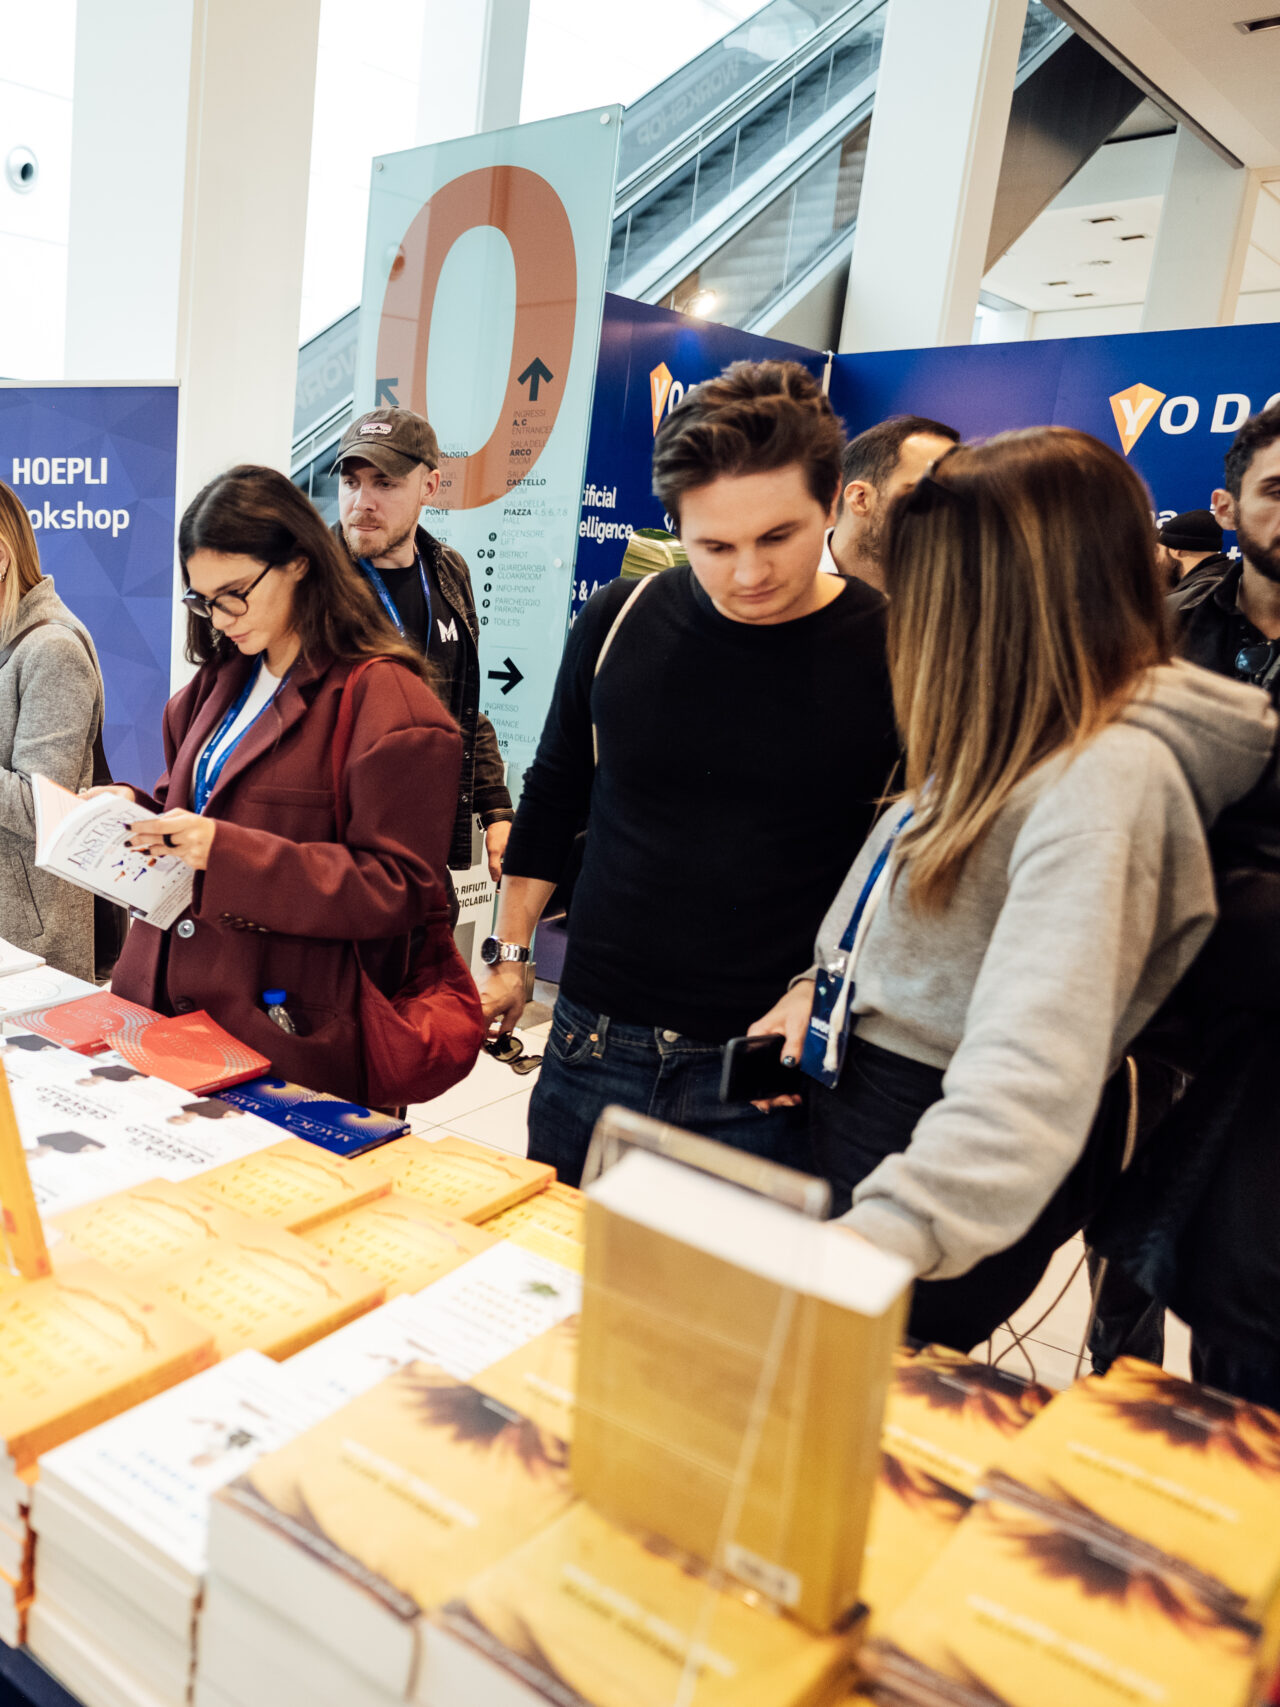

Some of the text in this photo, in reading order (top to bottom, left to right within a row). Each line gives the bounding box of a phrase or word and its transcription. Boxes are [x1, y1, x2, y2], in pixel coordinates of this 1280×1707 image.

[513, 409, 546, 418] INGRESSI
[521, 418, 527, 426] C
[512, 426, 554, 435] ENTRANCES
[440, 451, 469, 459] OLOGIO
[510, 448, 531, 456] ARCO
[13, 457, 107, 485] HOEPLI
[506, 478, 547, 486] CASTELLO
[426, 508, 449, 516] PONTE
[503, 508, 532, 516] PIAZZA
[29, 501, 130, 538] okshop
[501, 529, 544, 538] ASCENSORE
[579, 515, 634, 544] elligence
[500, 551, 528, 559] BISTROT
[497, 563, 546, 572] GUARDAROBA
[497, 572, 542, 580] CLOAKROOM
[496, 585, 535, 593] INFO-POINT
[495, 597, 541, 607] PARCHEGGIO
[494, 618, 520, 626] TOILETS
[485, 702, 519, 712] INGRESSO
[493, 718, 519, 728] TRANCE
[498, 731, 536, 743] ERIA DELLA
[461, 881, 487, 893] RIFIUTI
[458, 894, 492, 908] CICLABILI
[285, 1114, 352, 1143] MAGICA
